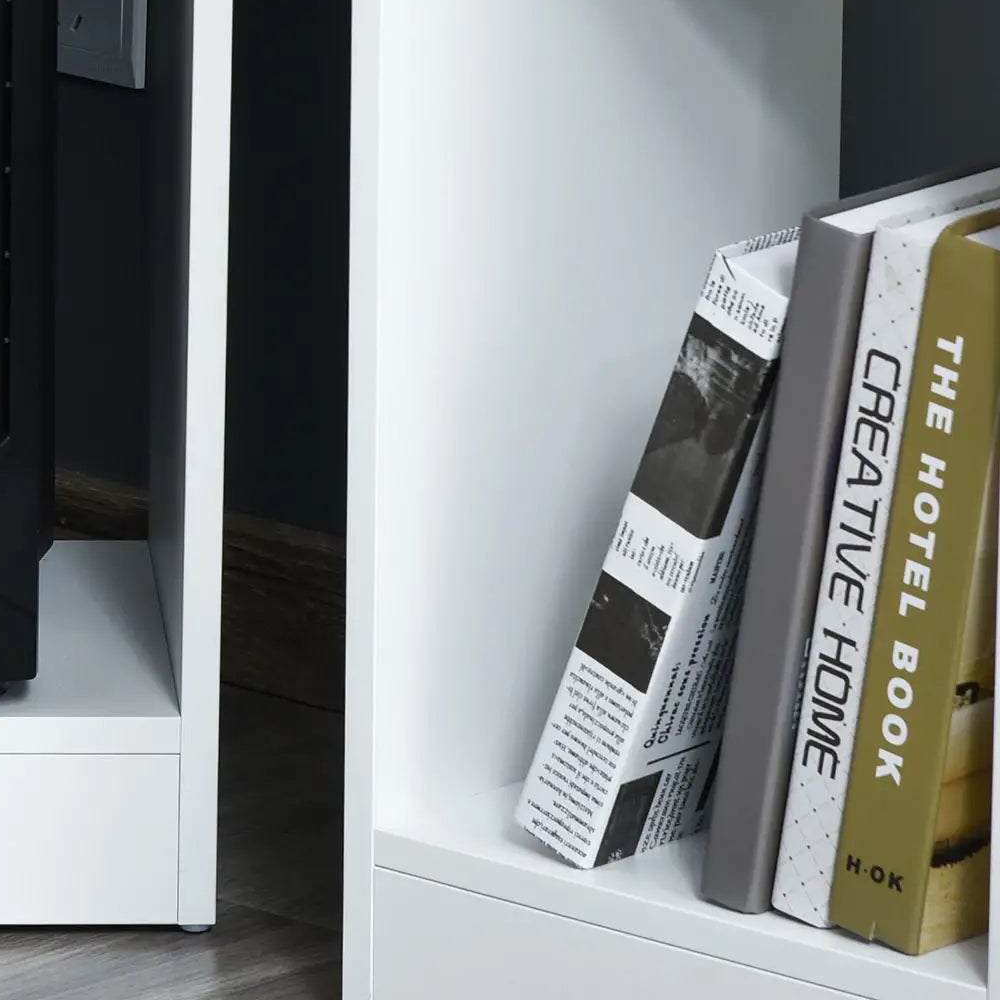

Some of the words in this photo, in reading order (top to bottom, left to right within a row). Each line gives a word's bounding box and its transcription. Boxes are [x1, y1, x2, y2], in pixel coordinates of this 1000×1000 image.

[925, 335, 964, 434] THE
[828, 348, 901, 614] CREATIVE
[898, 453, 946, 617] HOTEL
[802, 627, 858, 780] HOME
[875, 640, 919, 786] BOOK
